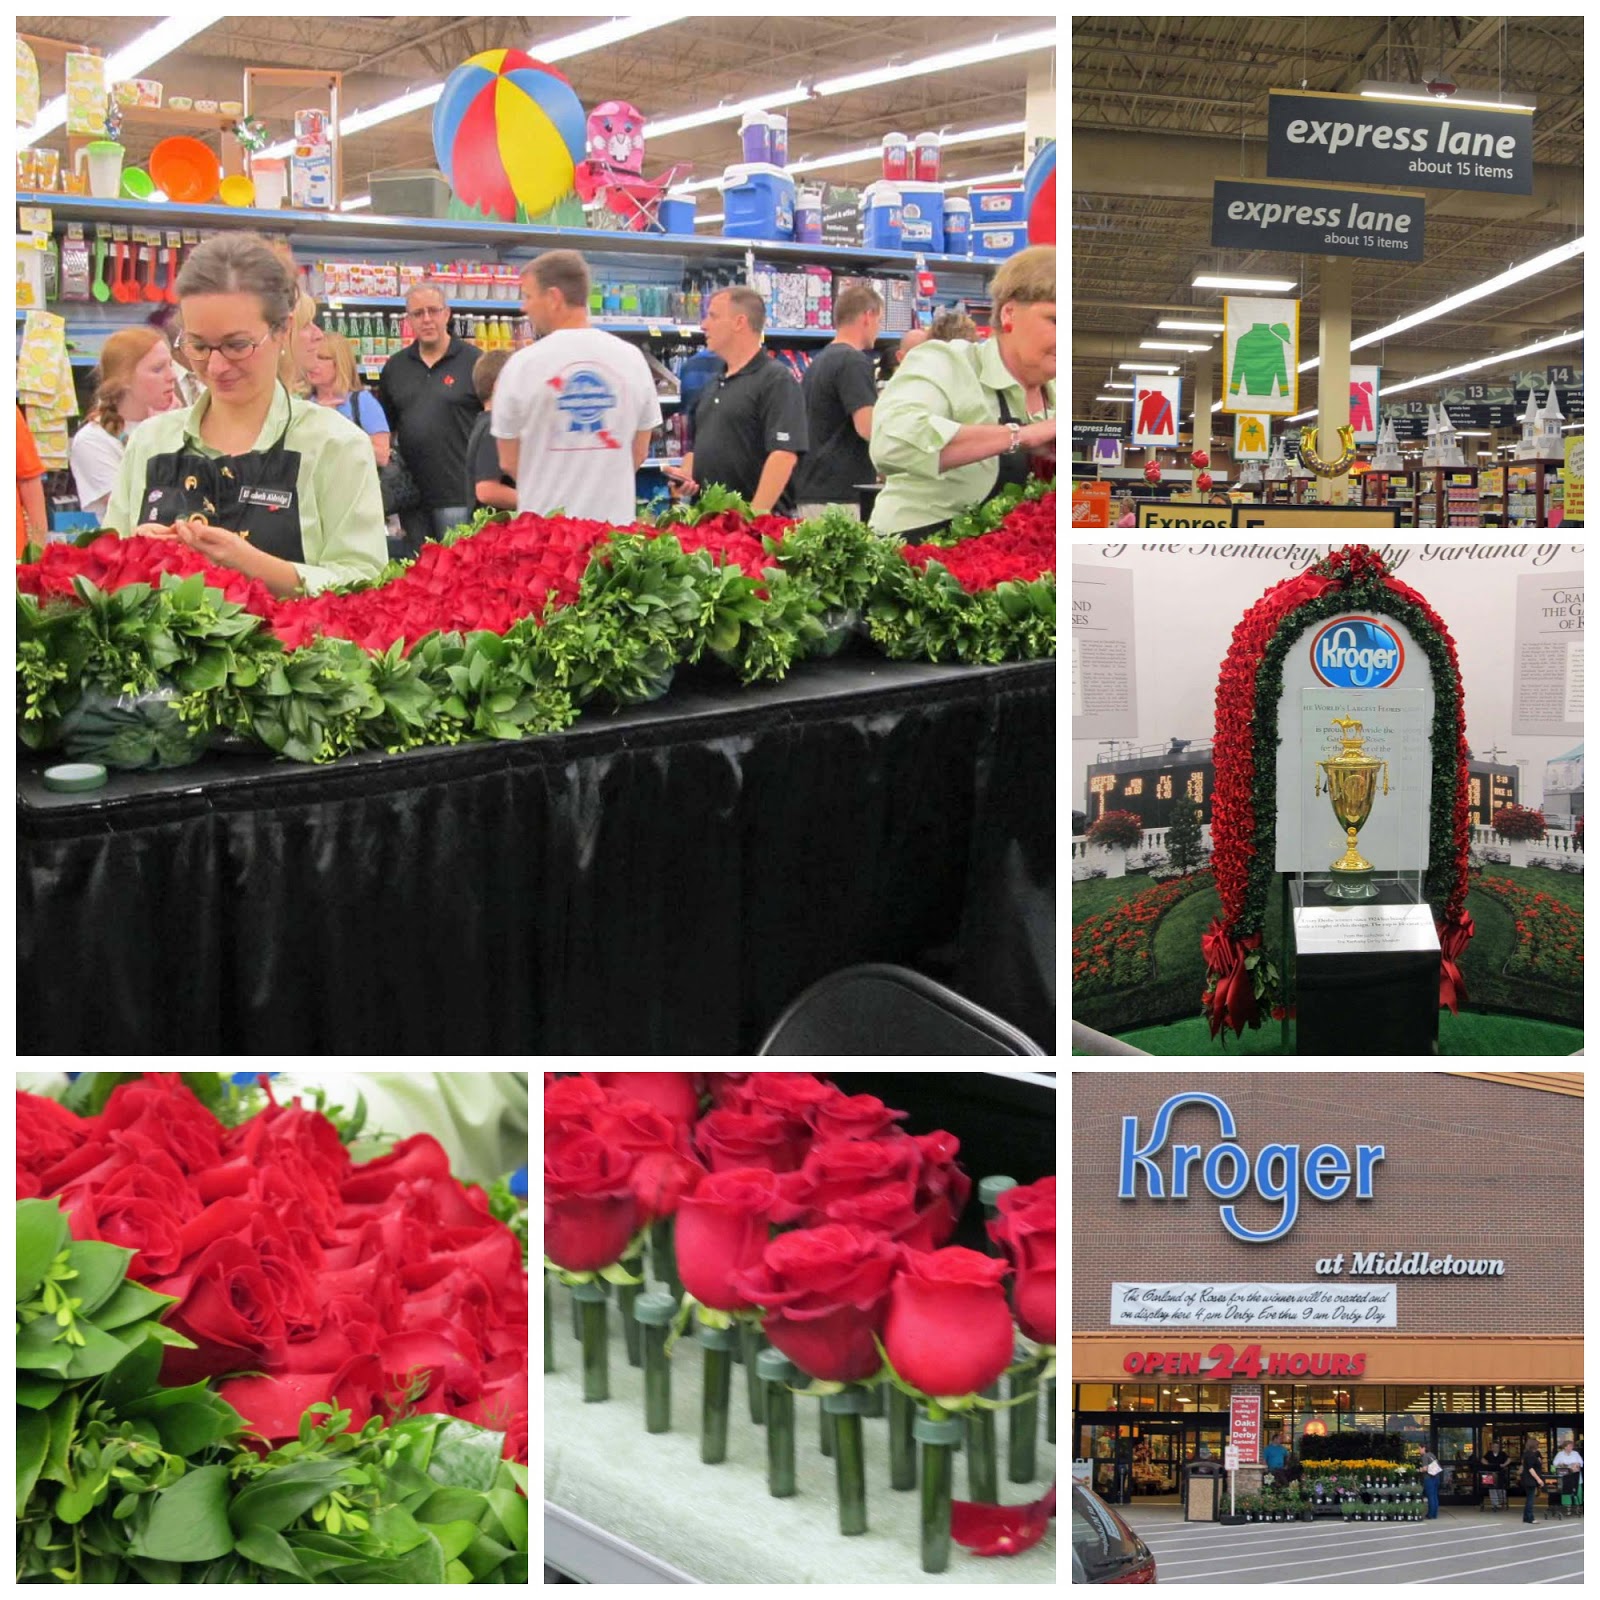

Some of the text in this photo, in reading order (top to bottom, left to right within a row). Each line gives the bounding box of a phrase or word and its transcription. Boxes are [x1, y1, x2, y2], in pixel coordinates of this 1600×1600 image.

[1286, 119, 1516, 158] express lane
[1408, 158, 1513, 178] about 15 items
[1227, 200, 1412, 233] express lane
[1324, 232, 1408, 249] about 15 items
[1550, 368, 1568, 382] 14
[1468, 386, 1484, 398] 13
[1409, 402, 1423, 413] 12
[1073, 424, 1122, 433] express lane
[1145, 513, 1233, 528] Expres
[1072, 601, 1092, 612] ND
[1542, 608, 1567, 617] THE
[1559, 620, 1575, 629] OF
[1322, 627, 1396, 686] Kroger
[1347, 704, 1376, 712] LARGEST
[1118, 1092, 1385, 1243] Kroger
[1314, 1252, 1506, 1276] at Middletown
[1123, 1287, 1390, 1306] The Garland of Roses for the winner will be created and
[1120, 1305, 1386, 1323] on display here 4 pm Derby Eve thru 9 am Derby Day
[1122, 1343, 1367, 1379] OPEN 24 HOURS
